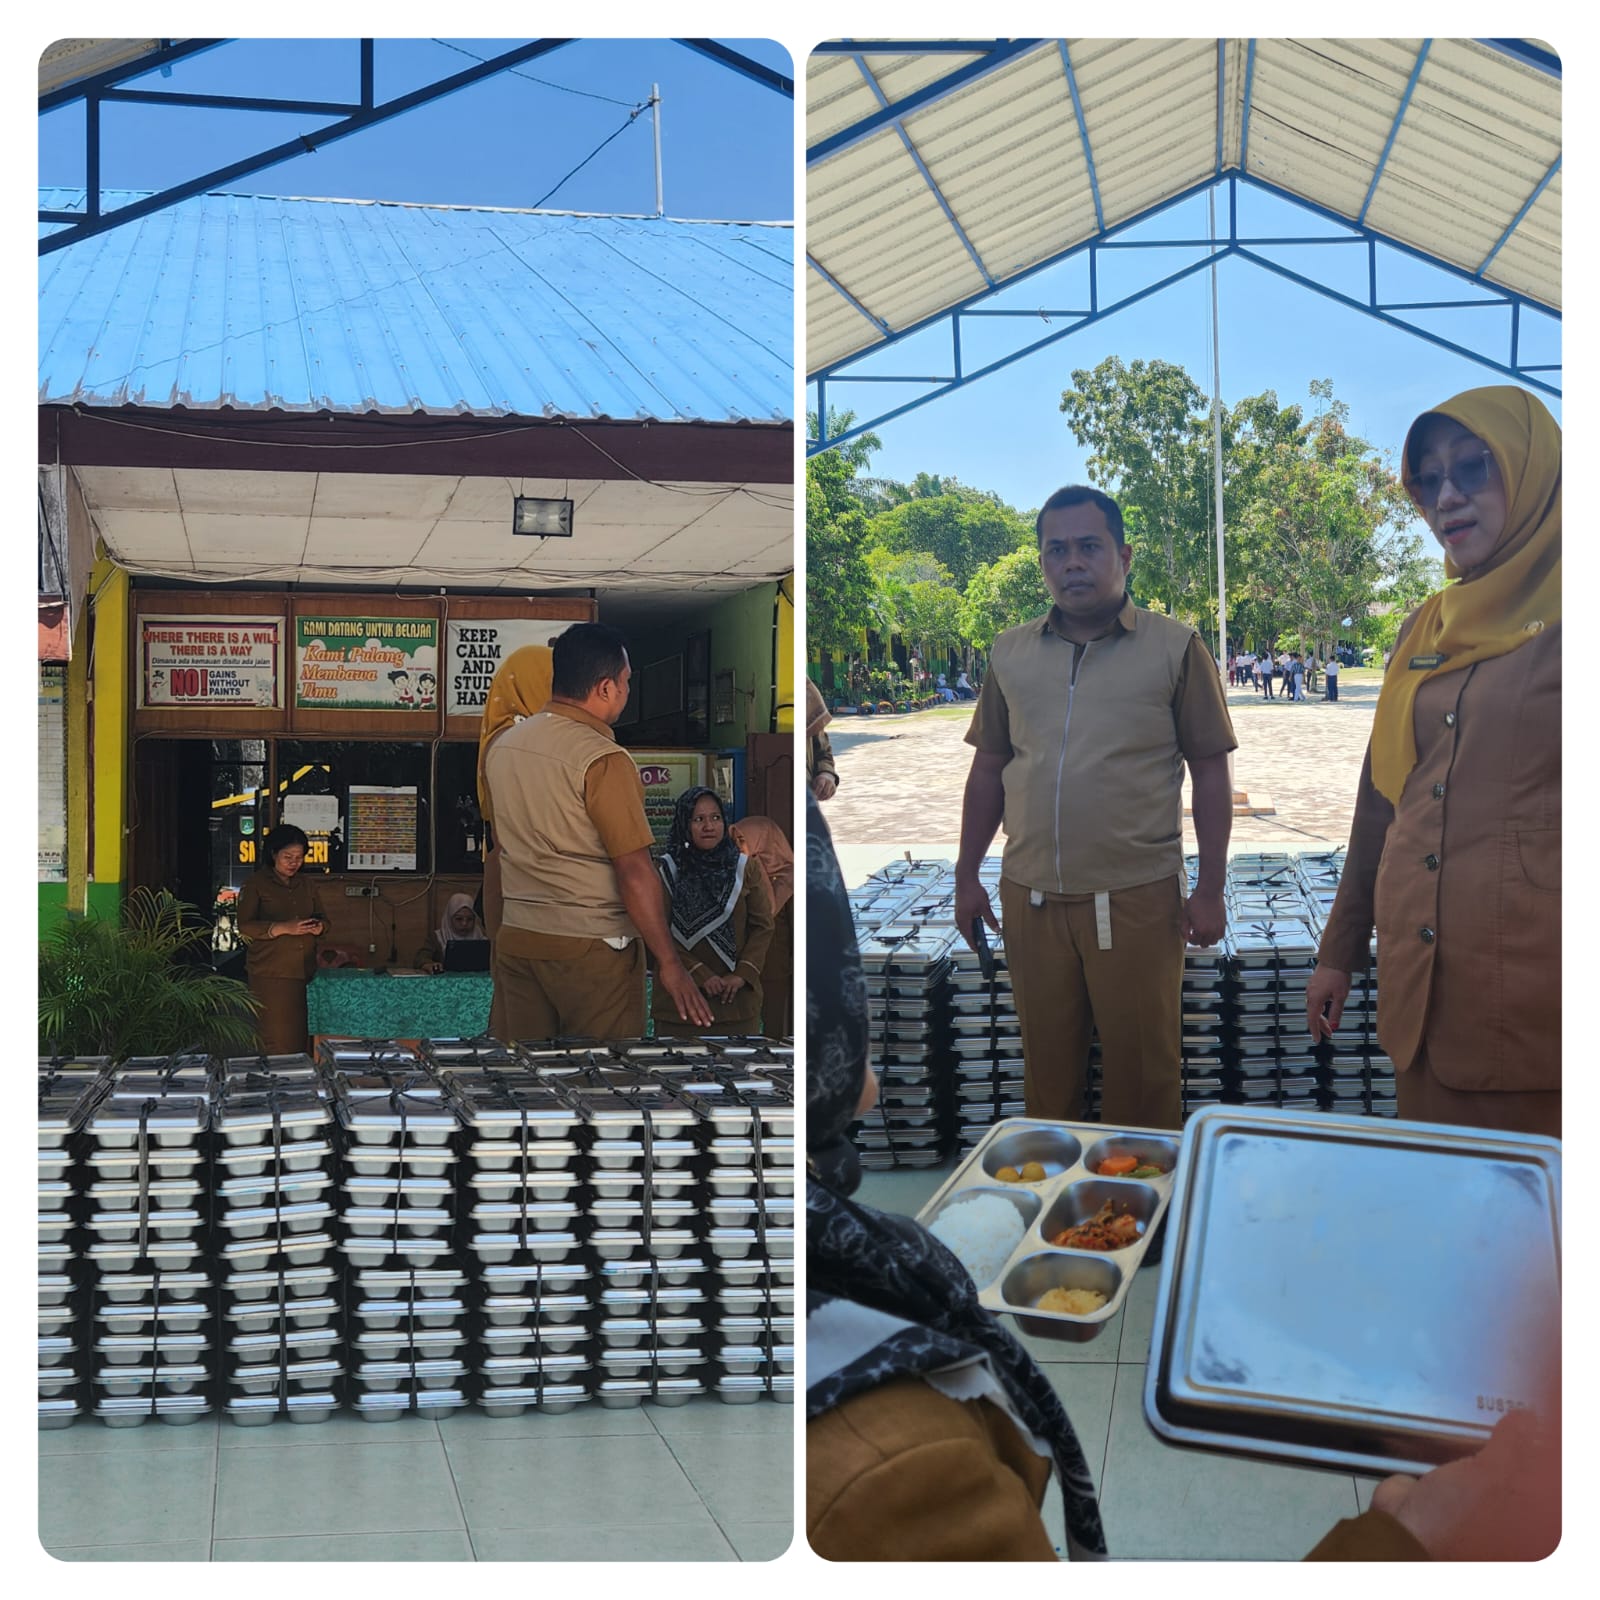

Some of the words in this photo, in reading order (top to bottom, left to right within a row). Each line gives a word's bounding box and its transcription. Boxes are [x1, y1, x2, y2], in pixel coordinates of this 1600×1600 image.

[303, 621, 326, 636] KAMI
[328, 621, 364, 637] DATANG
[365, 622, 394, 637] UNTUK
[395, 623, 432, 638] BELAJAR
[459, 628, 498, 643] KEEP
[143, 631, 183, 643] WHERE
[186, 632, 224, 644] THERE
[228, 633, 239, 644] IS
[239, 633, 250, 644] A
[170, 645, 204, 656] THERE
[207, 645, 217, 656] IS
[218, 646, 228, 656] A
[230, 646, 253, 656] WAY
[303, 645, 346, 662] Kami
[349, 646, 405, 668] Pulang
[456, 644, 501, 658] CALM
[209, 670, 236, 679] GAINS
[302, 664, 377, 680] Membawa
[461, 660, 495, 674] AND
[170, 668, 208, 697] NO!
[209, 679, 250, 687] WITHOUT
[302, 682, 338, 698] Ilmu
[454, 675, 493, 690] STUD
[209, 687, 241, 696] PAINTS
[456, 691, 488, 706] HAR
